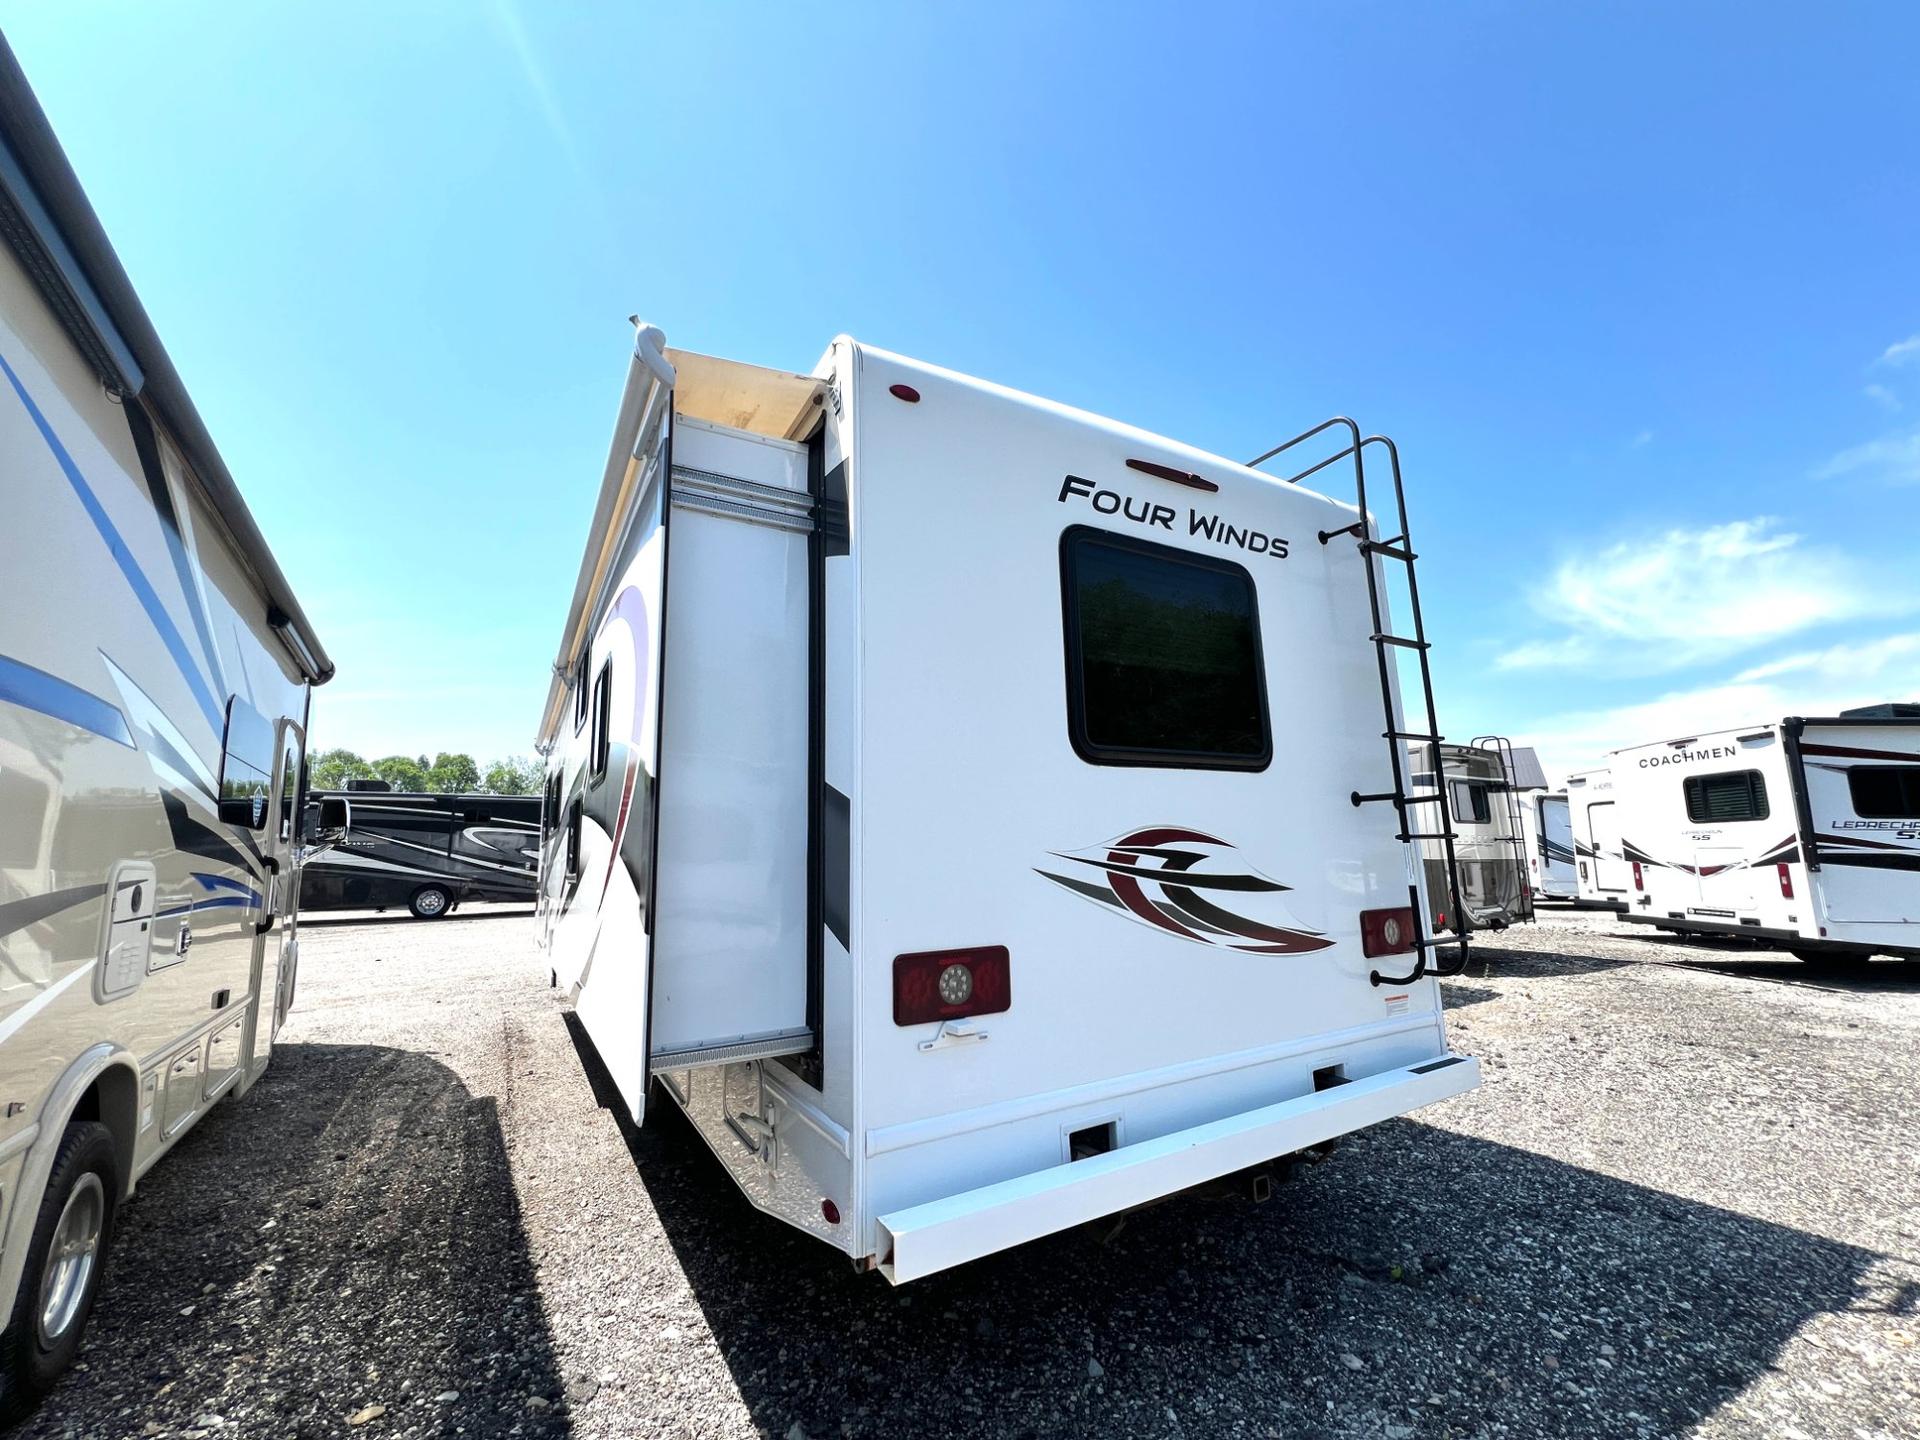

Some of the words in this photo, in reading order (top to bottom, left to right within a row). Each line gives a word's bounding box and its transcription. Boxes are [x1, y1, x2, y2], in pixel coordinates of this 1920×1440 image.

[1058, 474, 1176, 530] FOUR
[1189, 508, 1289, 559] WINDS
[1639, 745, 1736, 769] COACHMEN
